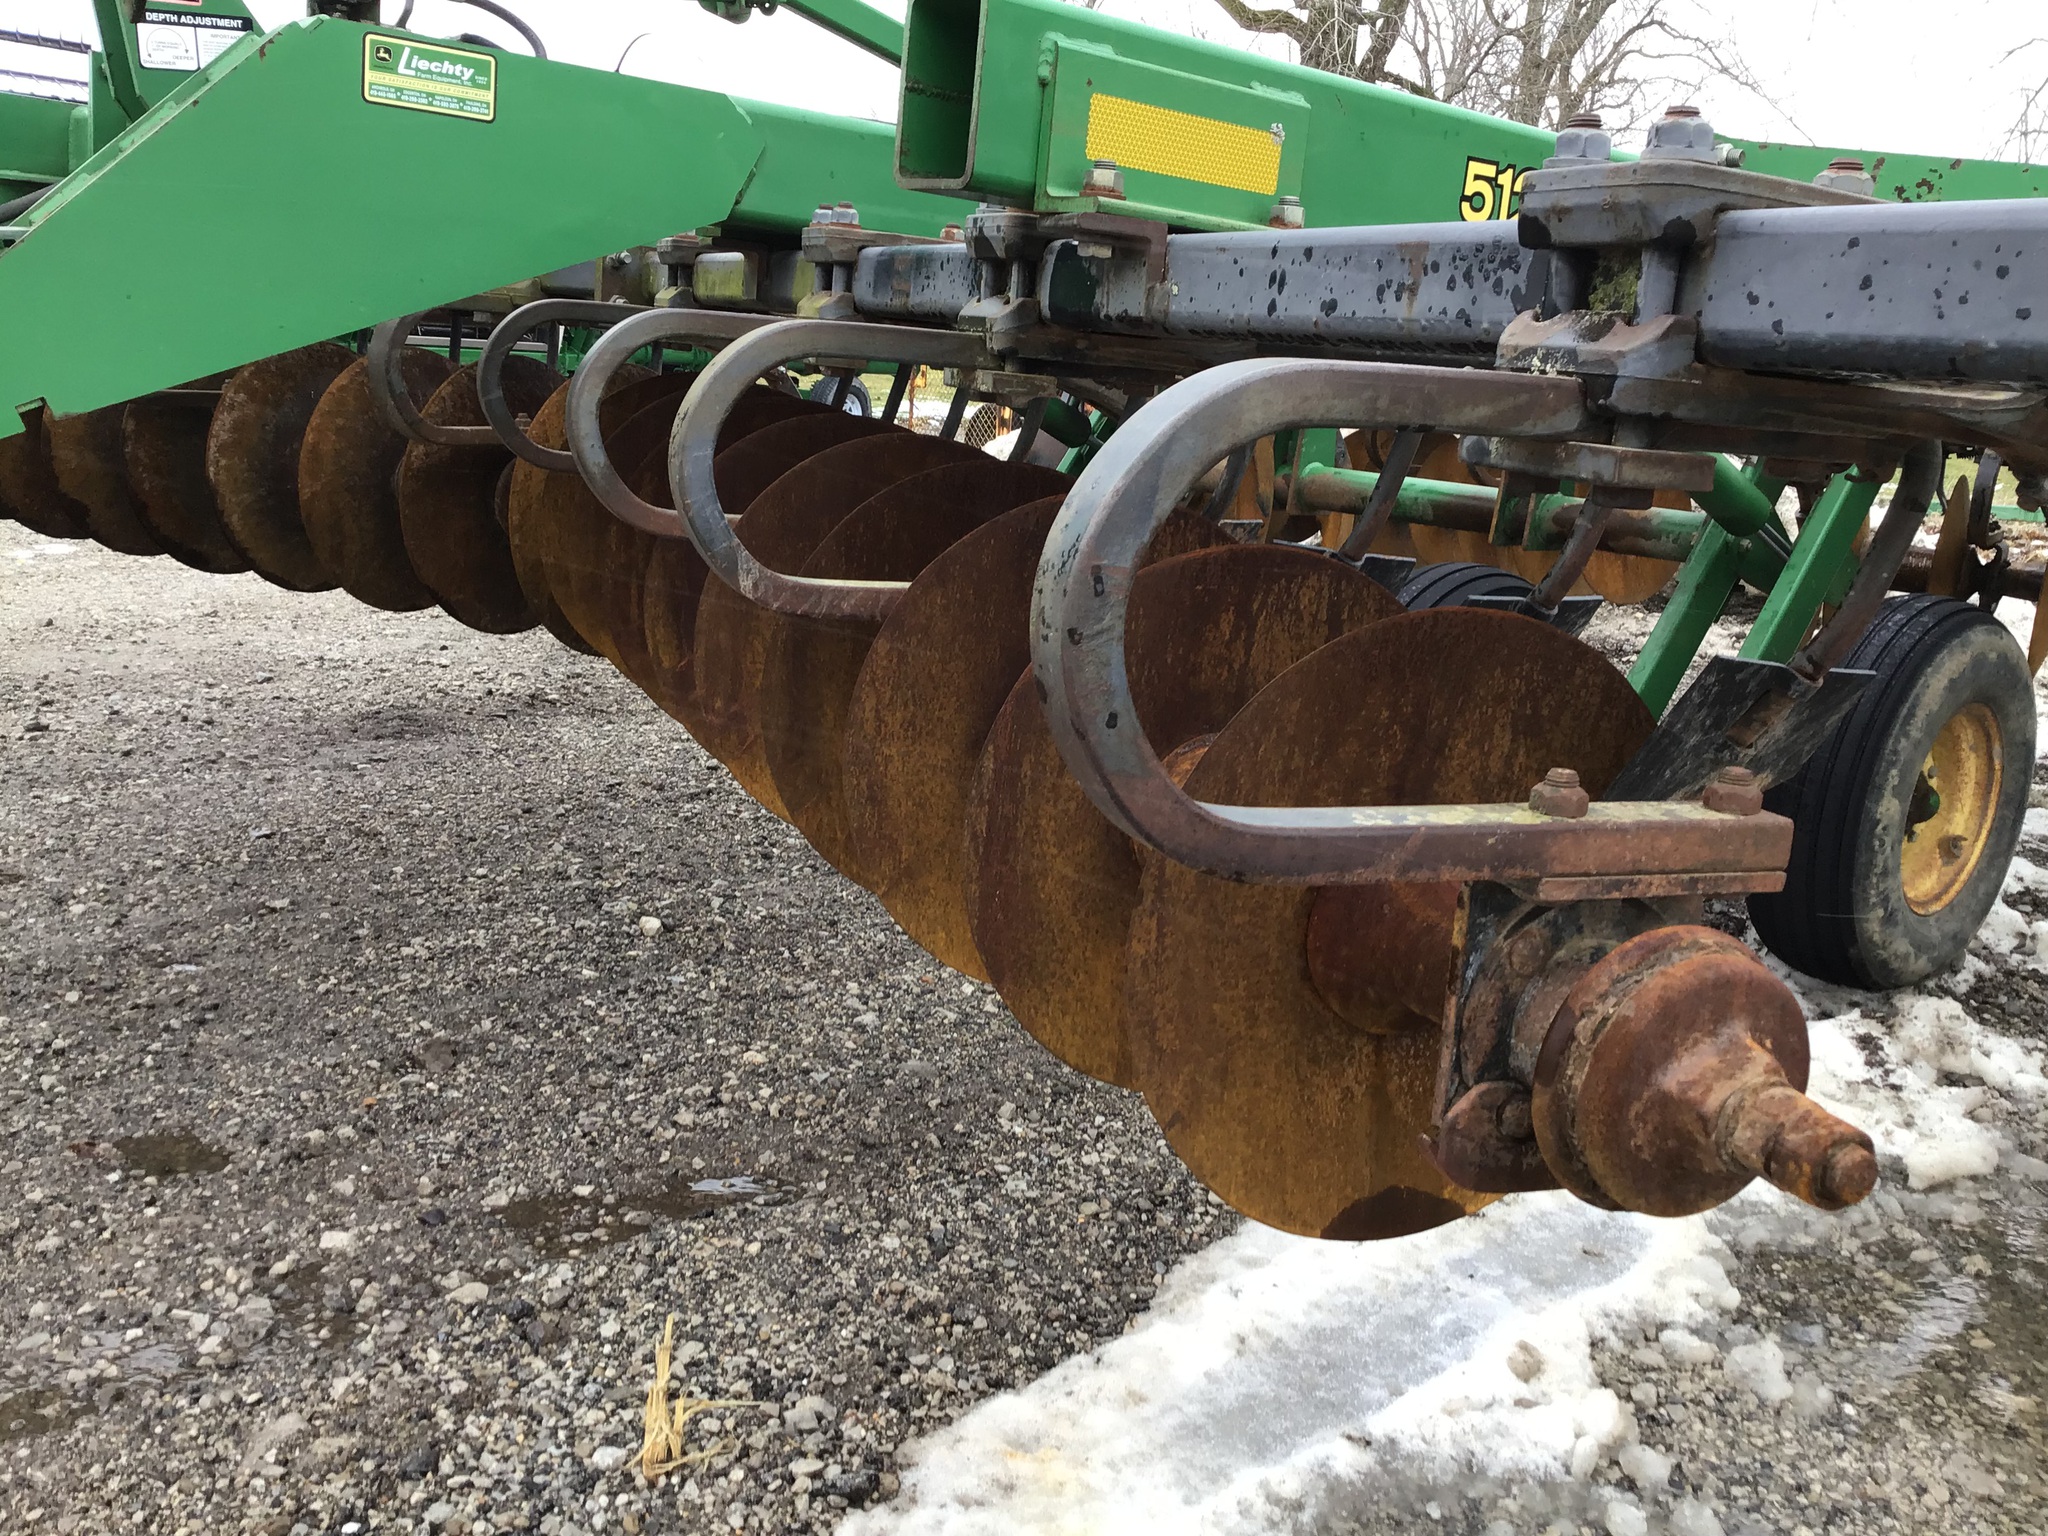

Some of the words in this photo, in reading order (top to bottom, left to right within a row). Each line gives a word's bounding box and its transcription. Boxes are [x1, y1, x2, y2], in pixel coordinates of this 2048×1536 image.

[145, 12, 178, 23] DEPTH
[180, 15, 243, 28] ADJUSTMENT
[142, 58, 176, 66] SHALLOWER
[398, 46, 474, 80] Liechty
[432, 74, 462, 85] Equipment,
[388, 78, 430, 88] SATISFACTION
[453, 88, 489, 98] COMMITMENT
